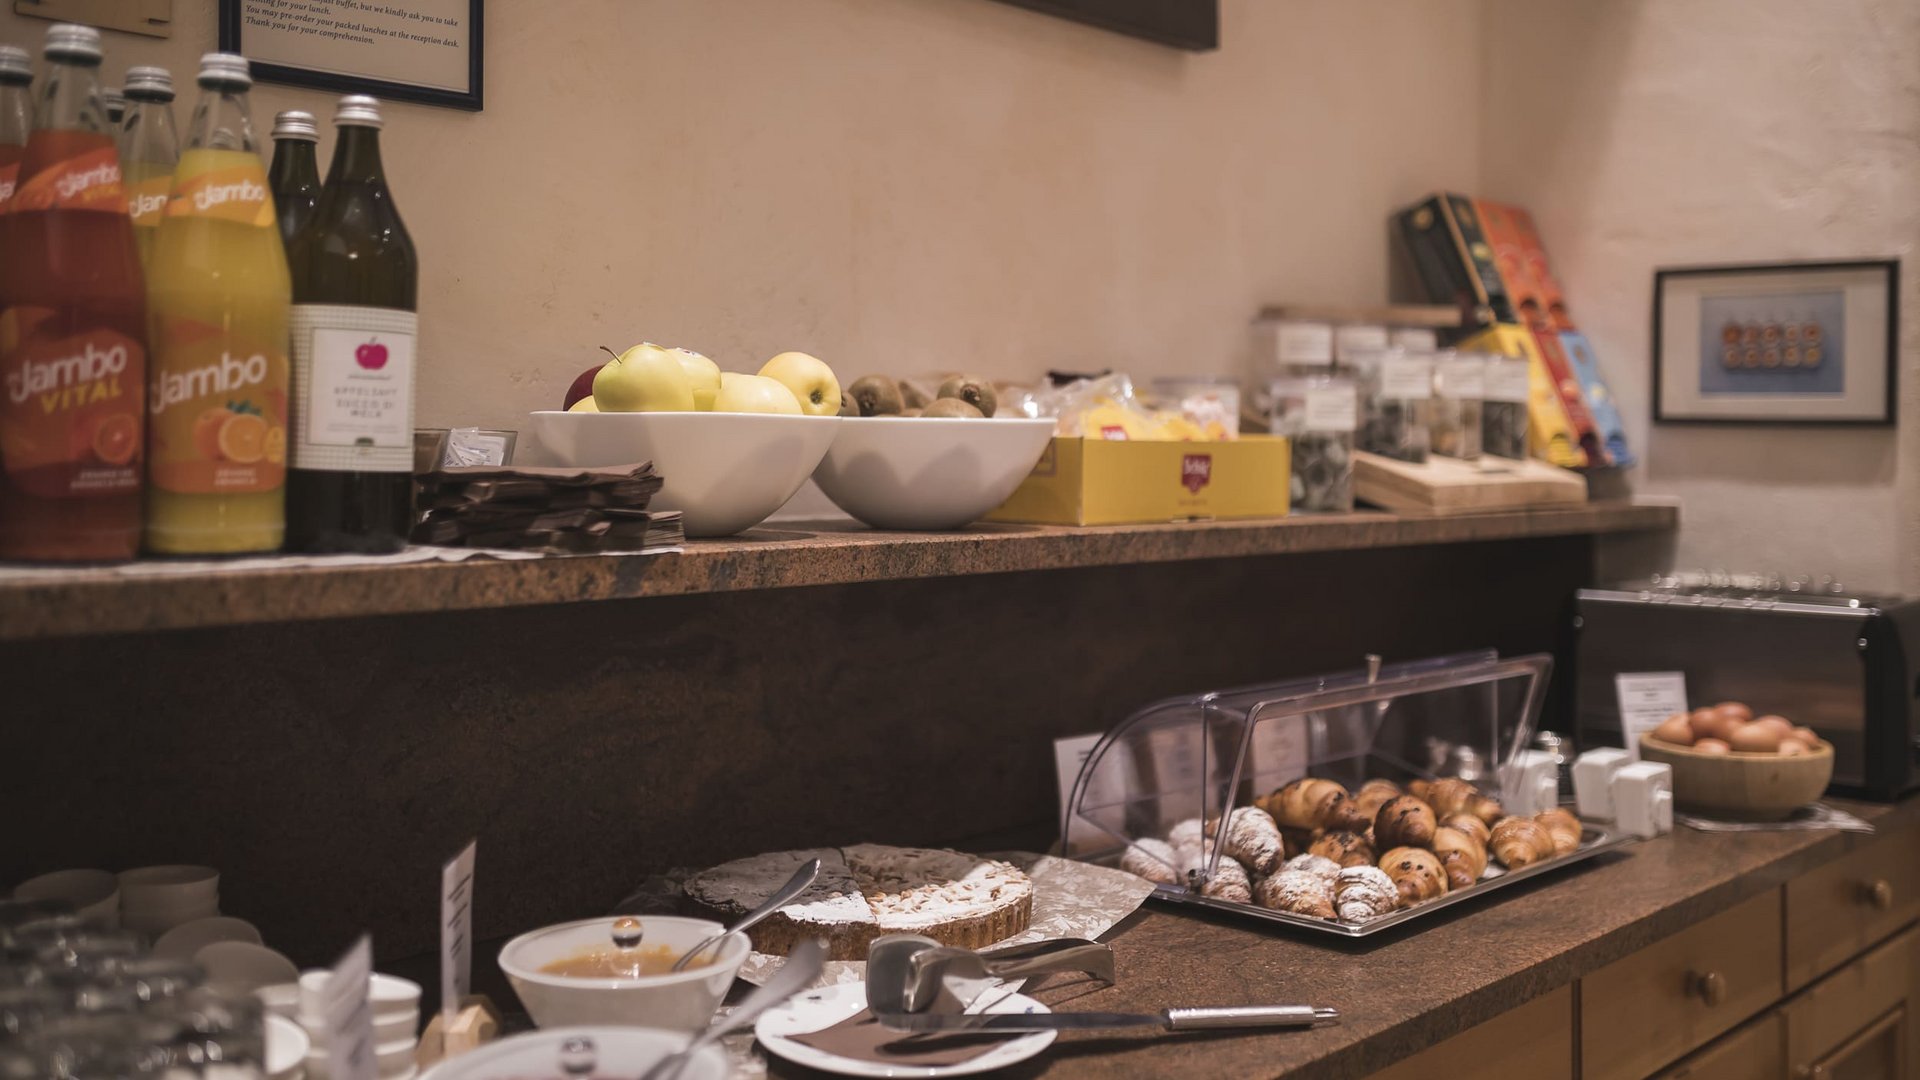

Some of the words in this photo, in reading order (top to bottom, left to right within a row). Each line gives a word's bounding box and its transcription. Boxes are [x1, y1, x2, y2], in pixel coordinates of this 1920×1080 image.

[246, 5, 260, 14] You
[262, 9, 279, 18] may
[280, 12, 315, 23] pre-order
[316, 18, 334, 26] your
[334, 21, 361, 31] packed
[361, 24, 388, 35] lunches
[398, 31, 409, 40] the
[411, 34, 441, 45] reception
[442, 38, 459, 47] desk.
[276, 0, 288, 8] for
[289, 2, 307, 10] your
[309, 4, 331, 15] lunch.
[360, 2, 373, 11] but
[385, 6, 408, 19] kindly
[409, 12, 420, 20] ask
[421, 15, 434, 23] you
[444, 18, 458, 27] take
[246, 16, 270, 27] Thank
[272, 22, 286, 30] you
[287, 23, 299, 32] for
[300, 26, 318, 35] your
[318, 30, 375, 44] comprehension.
[6, 342, 127, 403] Jambo
[150, 350, 267, 415] Jambo
[41, 376, 123, 414] VITAL
